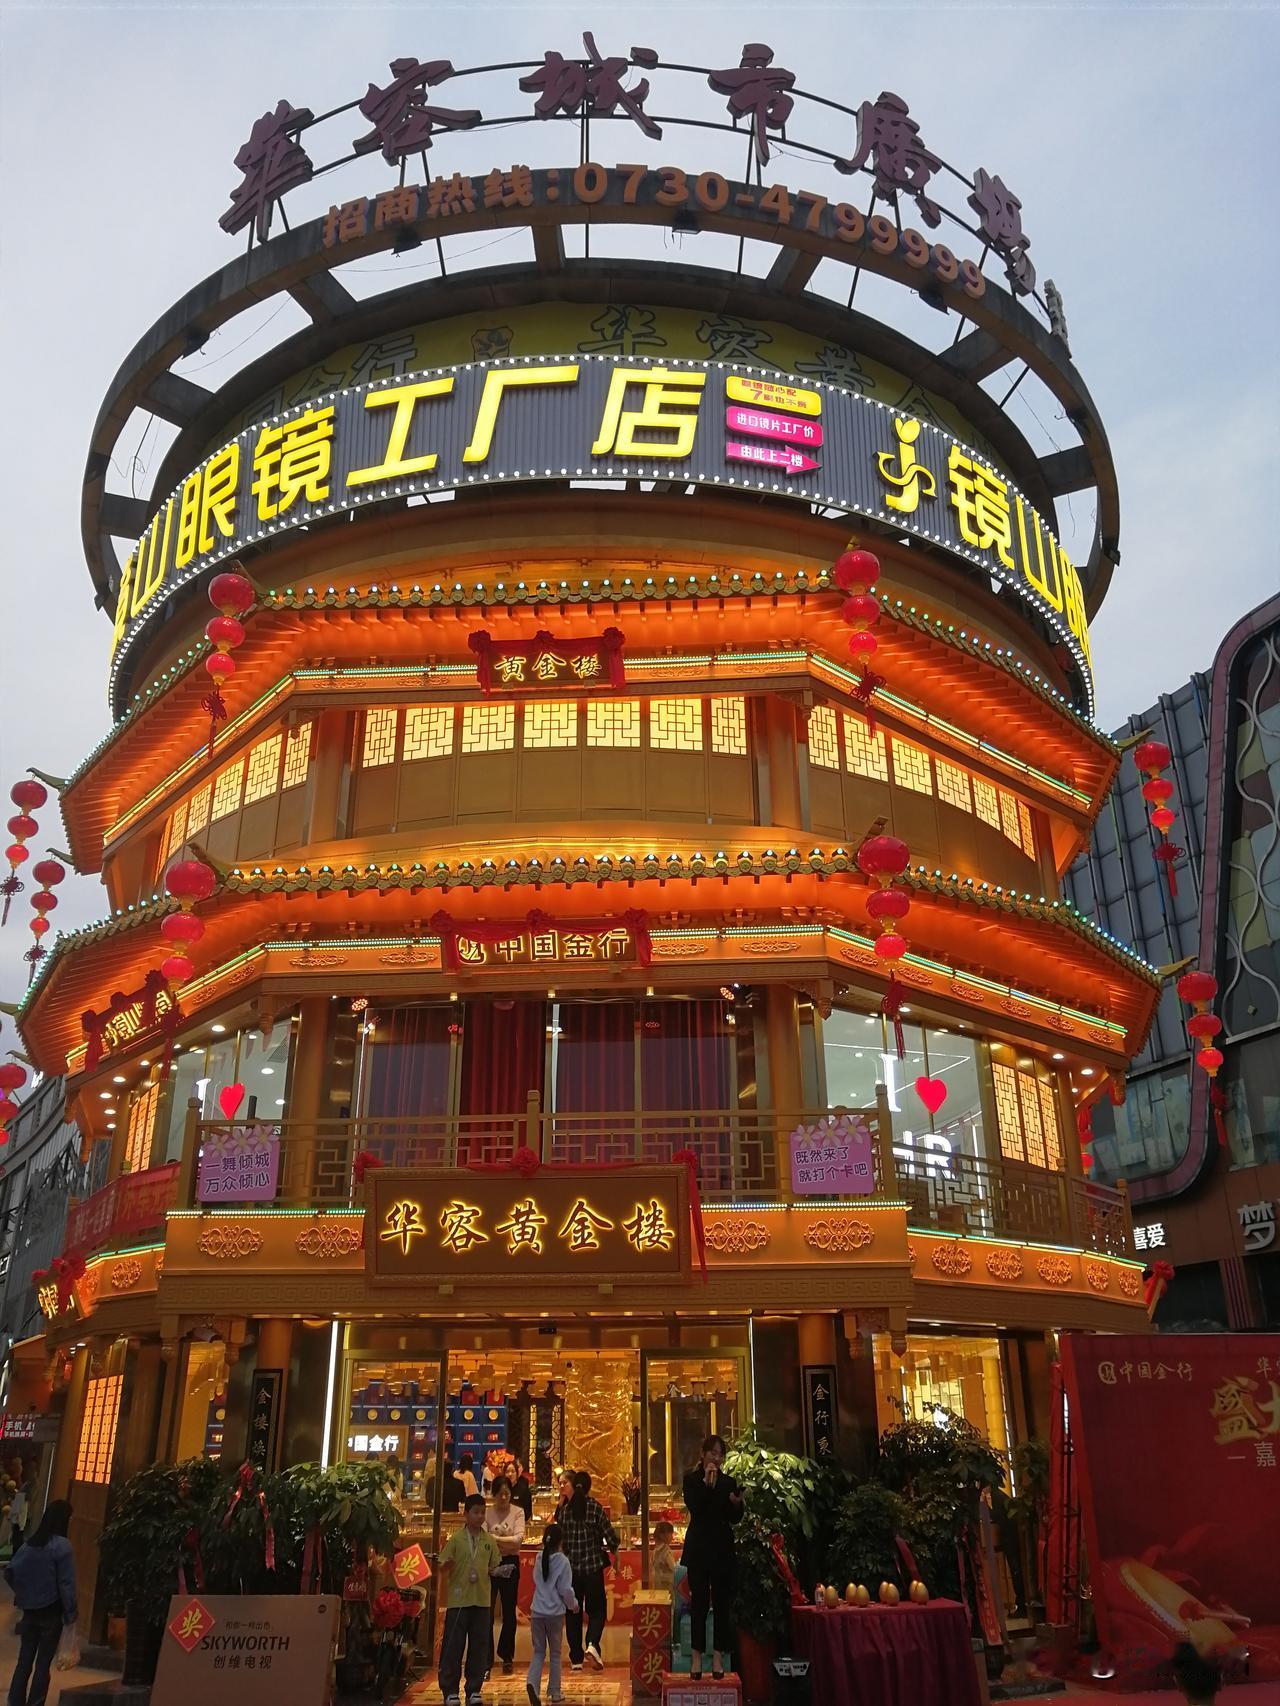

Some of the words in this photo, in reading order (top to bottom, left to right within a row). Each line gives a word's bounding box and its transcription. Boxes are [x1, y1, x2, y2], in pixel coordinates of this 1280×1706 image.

[737, 413, 814, 438] 进口镜片工厂价
[741, 445, 803, 467] 由此上二楼
[494, 651, 602, 682] 黄金楼
[495, 927, 630, 962] 中国金行
[205, 1152, 270, 1173] 一舞倾城
[795, 1146, 850, 1165] 既然来了
[204, 1171, 270, 1194] 万众倾心
[798, 1163, 868, 1184] 就打个卡吧
[380, 1199, 676, 1254] 华容黄金楼
[1237, 1200, 1276, 1251] 梦
[395, 1552, 421, 1582] 奖
[178, 1608, 203, 1639] 奖
[638, 1607, 662, 1638] 奖
[201, 1636, 290, 1650] SKYWORTH
[214, 1655, 272, 1669] 创维电视
[641, 1652, 664, 1684] 奖
